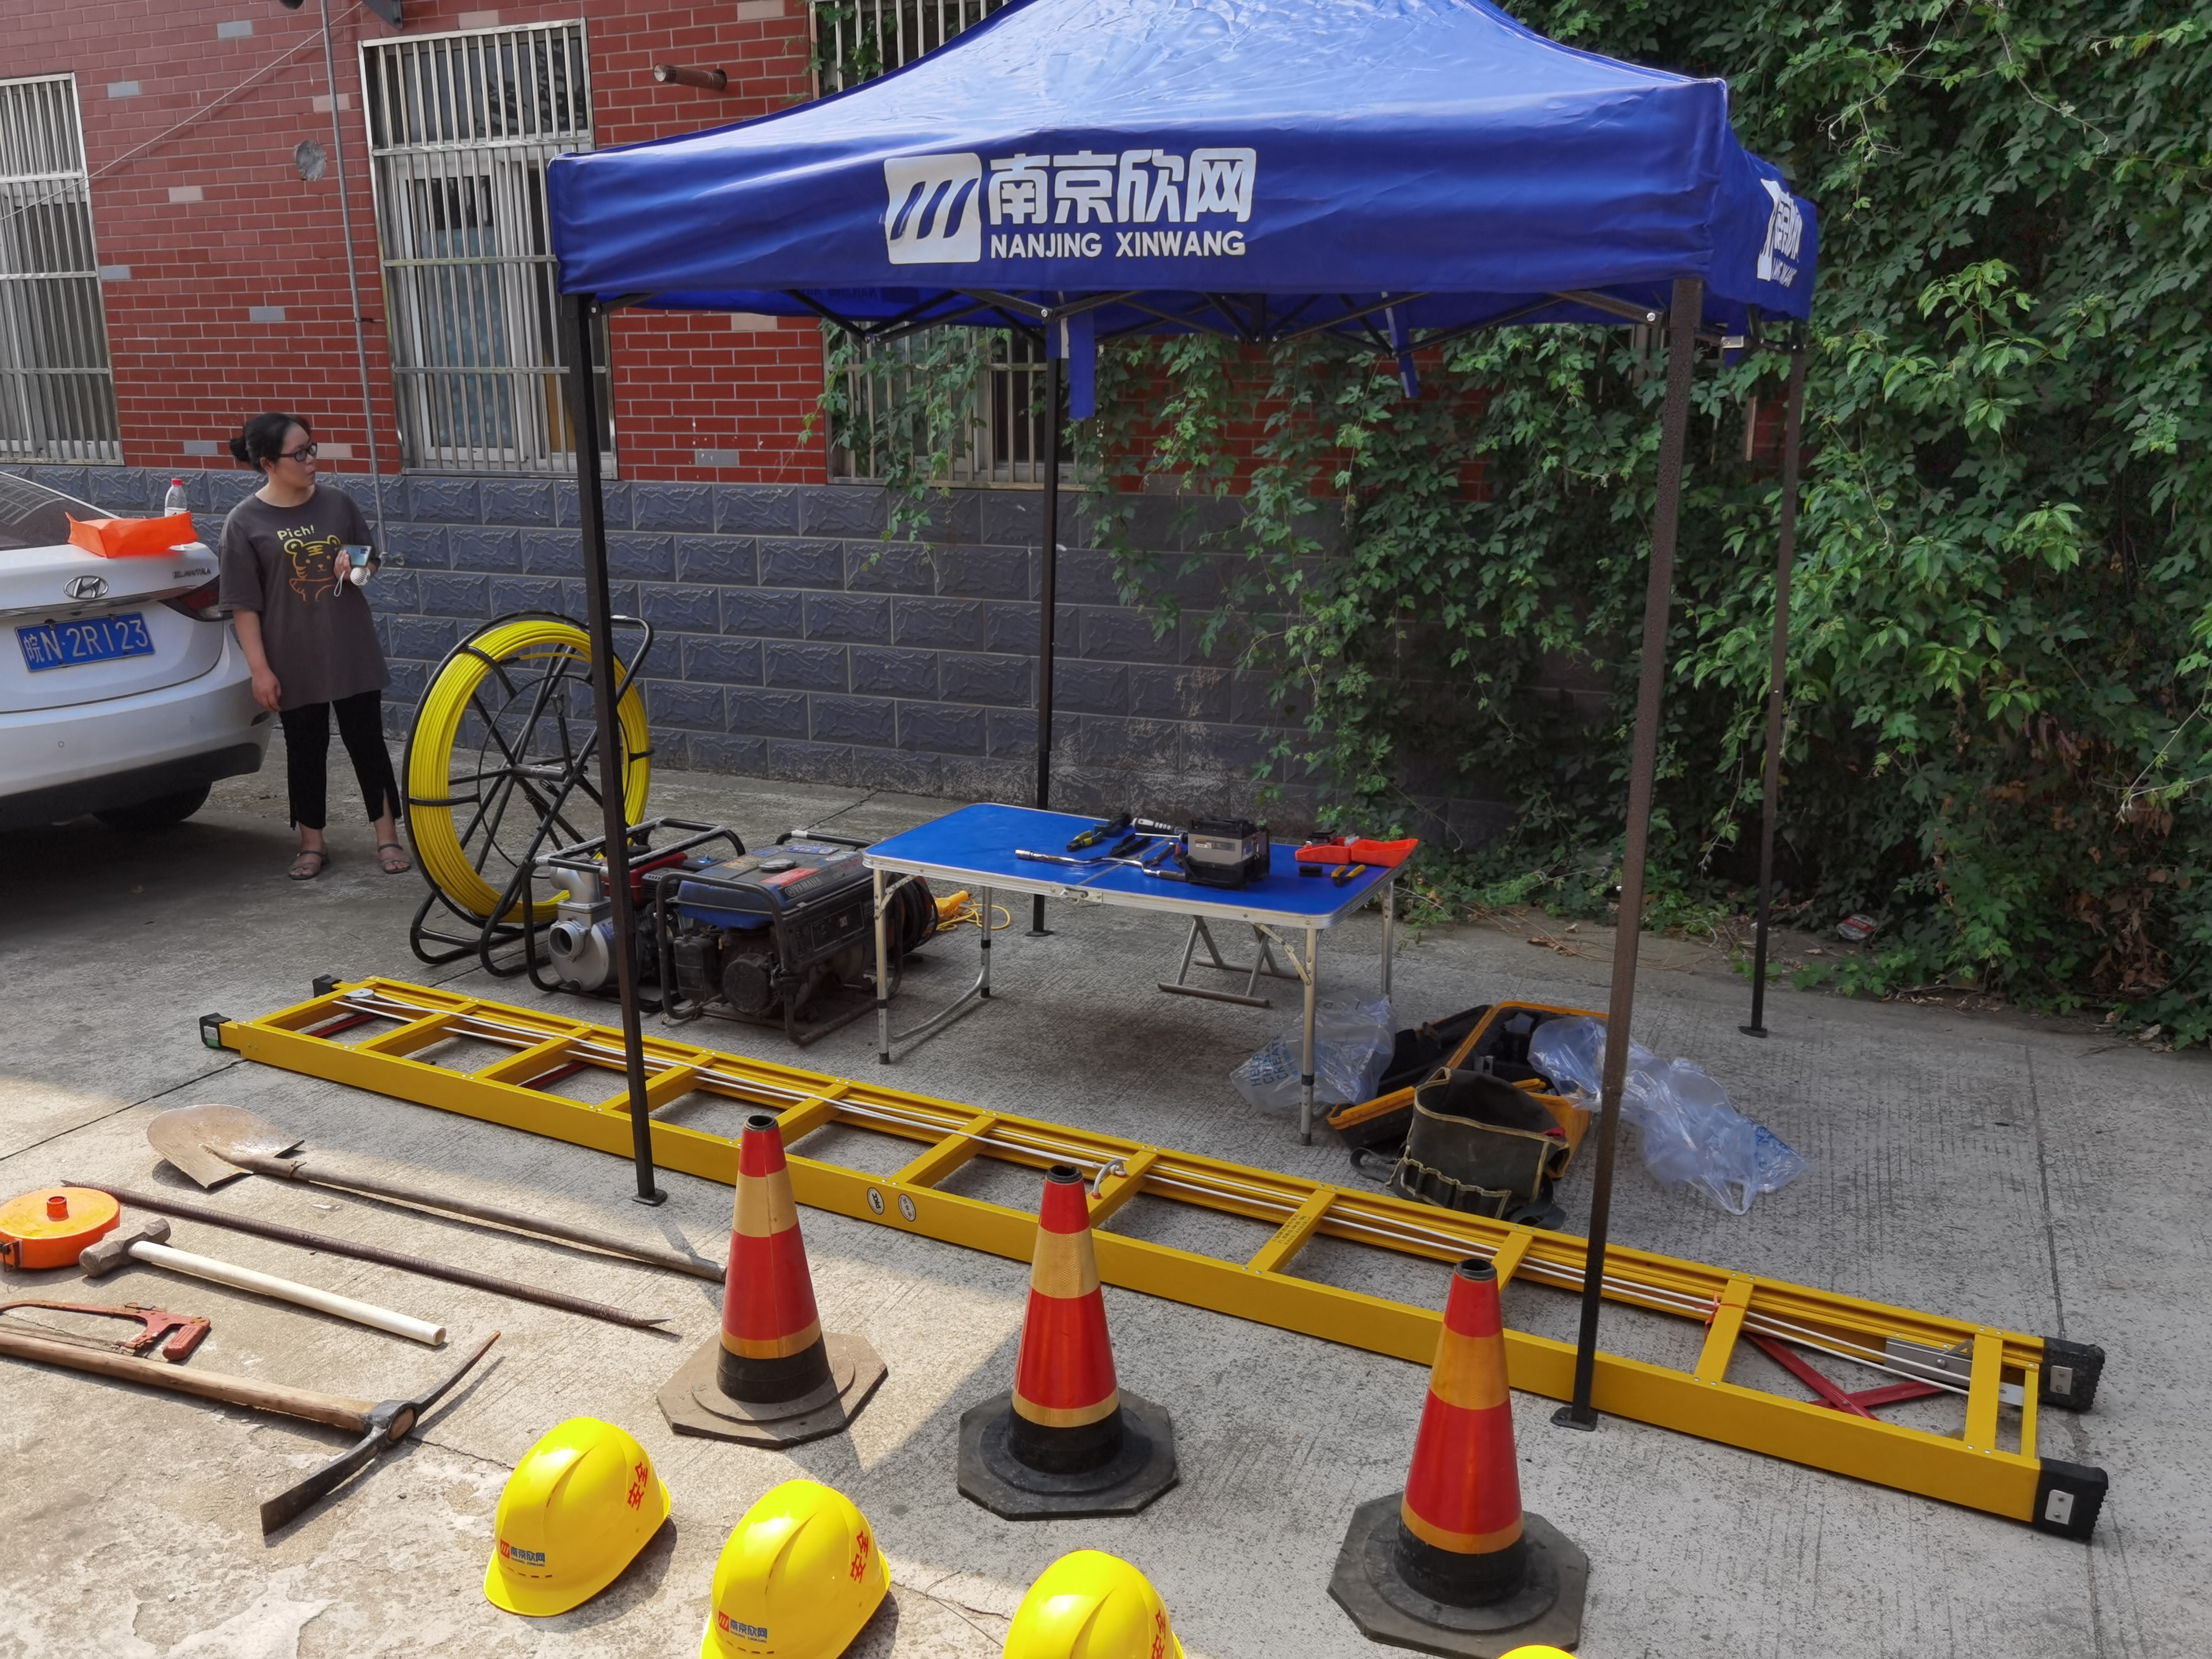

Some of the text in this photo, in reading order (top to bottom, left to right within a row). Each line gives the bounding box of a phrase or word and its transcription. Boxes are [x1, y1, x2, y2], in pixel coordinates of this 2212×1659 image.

[988, 147, 1257, 225] 南京欣网
[990, 231, 1246, 259] NANJING XINWANG
[276, 524, 315, 541] Pich!
[793, 876, 822, 894] YAMAHA
[627, 1461, 648, 1511] 安全
[850, 1529, 869, 1584] 安全
